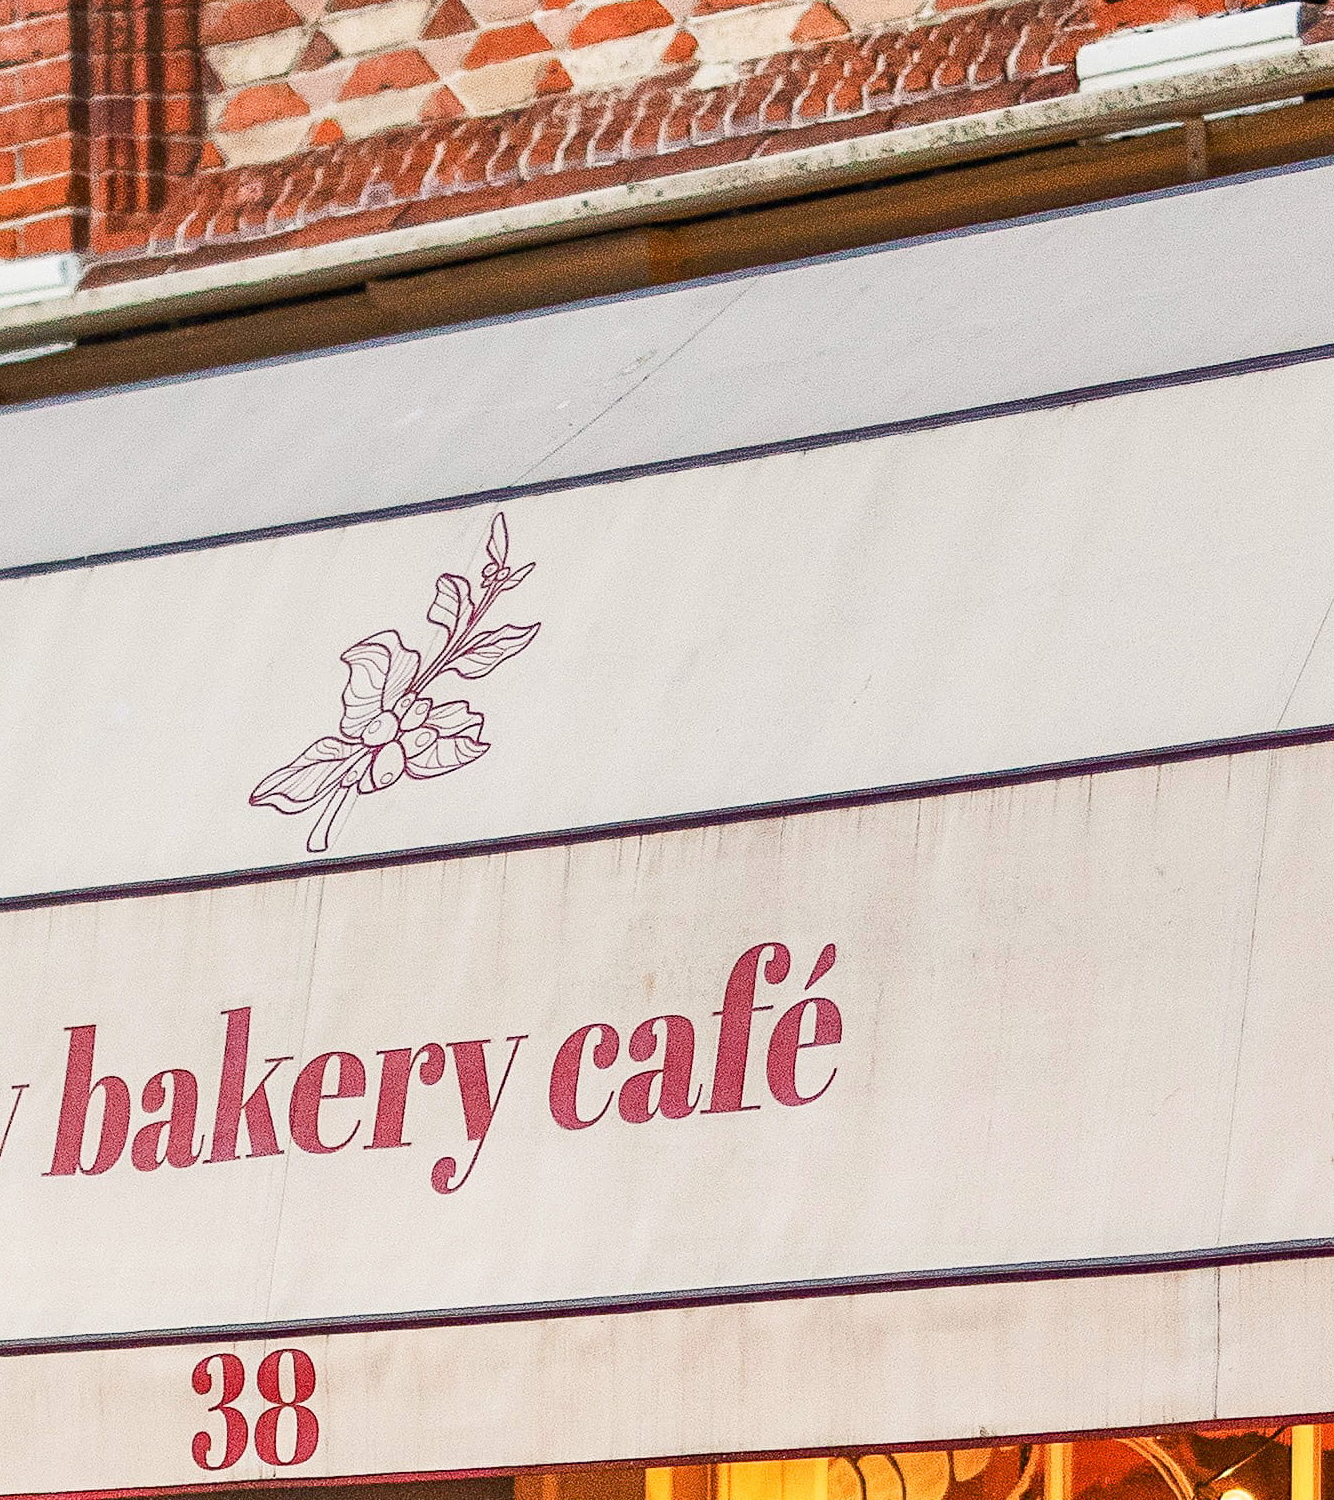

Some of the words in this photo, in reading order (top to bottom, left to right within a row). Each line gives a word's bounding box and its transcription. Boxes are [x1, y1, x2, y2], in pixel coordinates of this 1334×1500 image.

[41, 1005, 529, 1195] bakery
[548, 941, 844, 1131] café
[190, 1347, 320, 1472] 38
